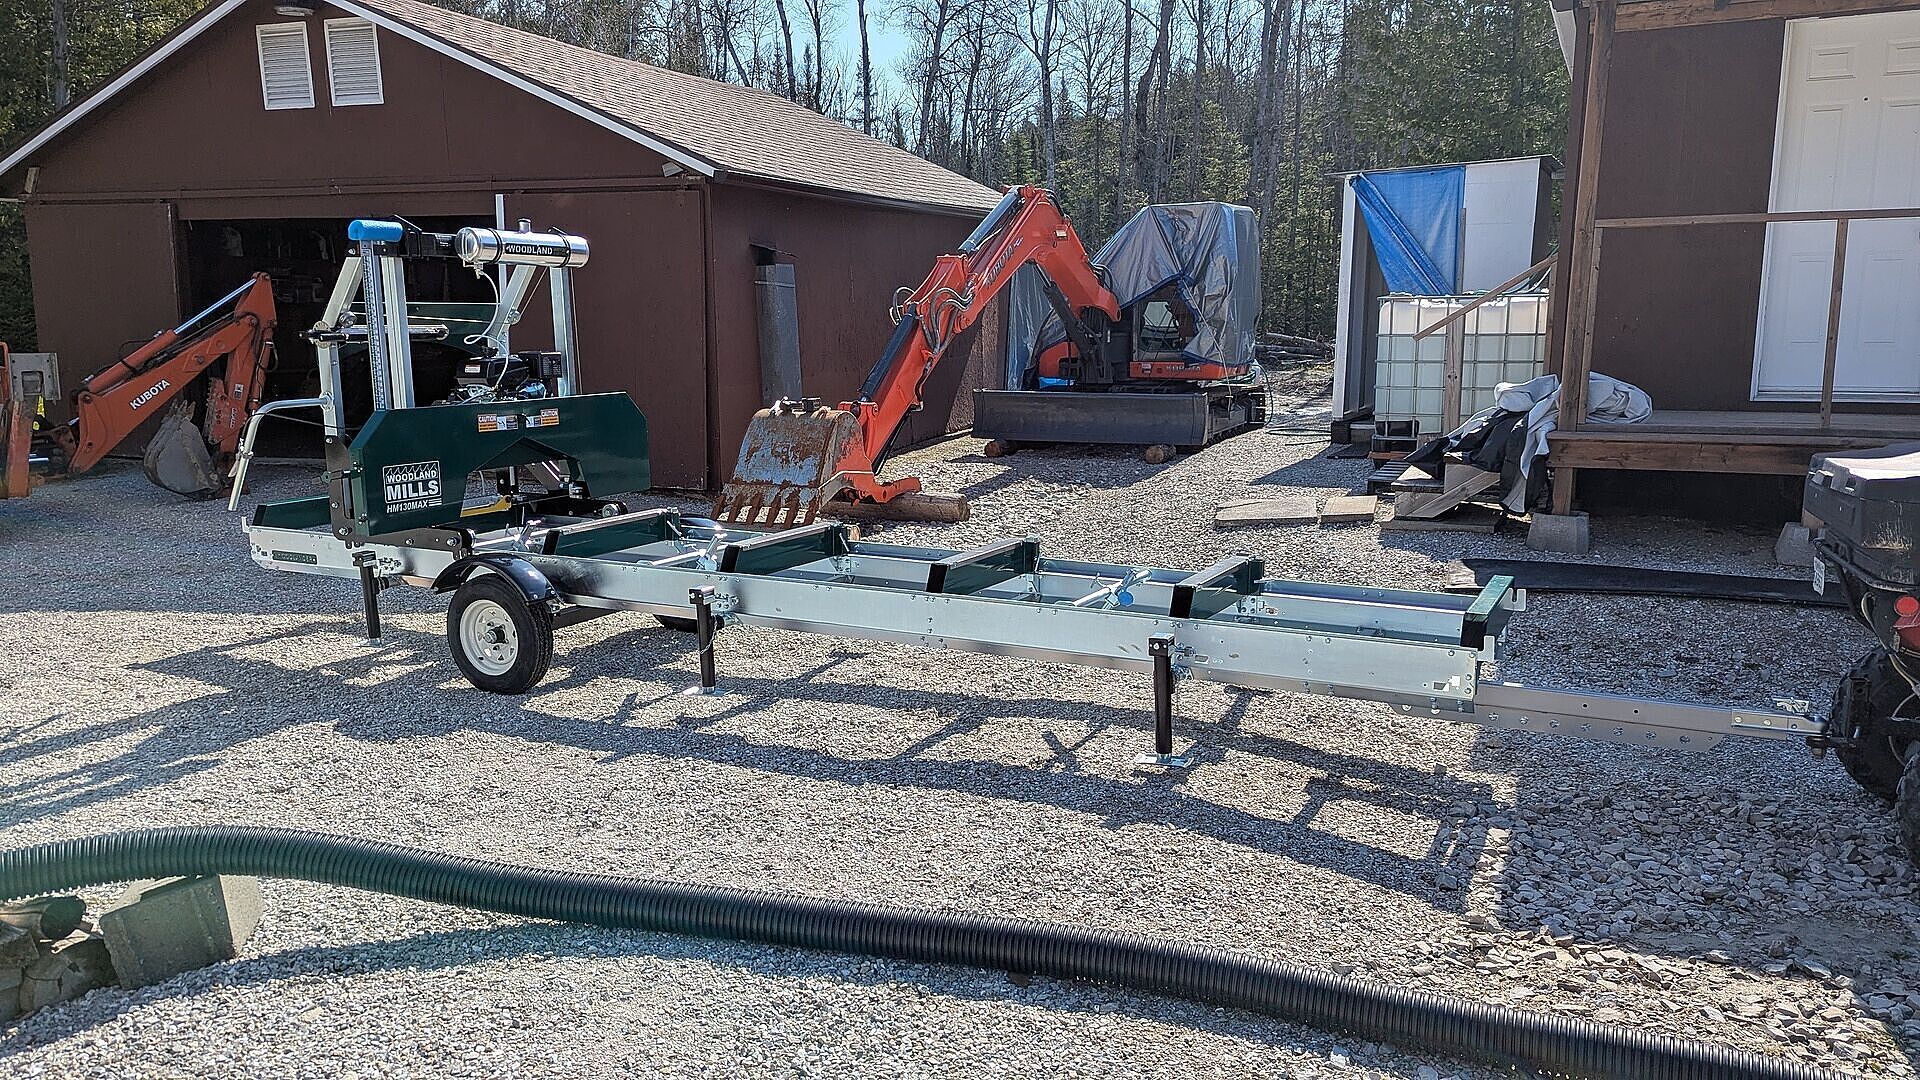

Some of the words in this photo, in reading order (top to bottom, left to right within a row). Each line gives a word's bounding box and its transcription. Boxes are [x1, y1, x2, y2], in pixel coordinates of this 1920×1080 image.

[507, 244, 553, 255] WOODLAND
[130, 380, 170, 409] KUBOTA
[387, 469, 437, 483] WOODLAND
[387, 480, 439, 501] MILLS
[387, 499, 429, 514] HM130MAX
